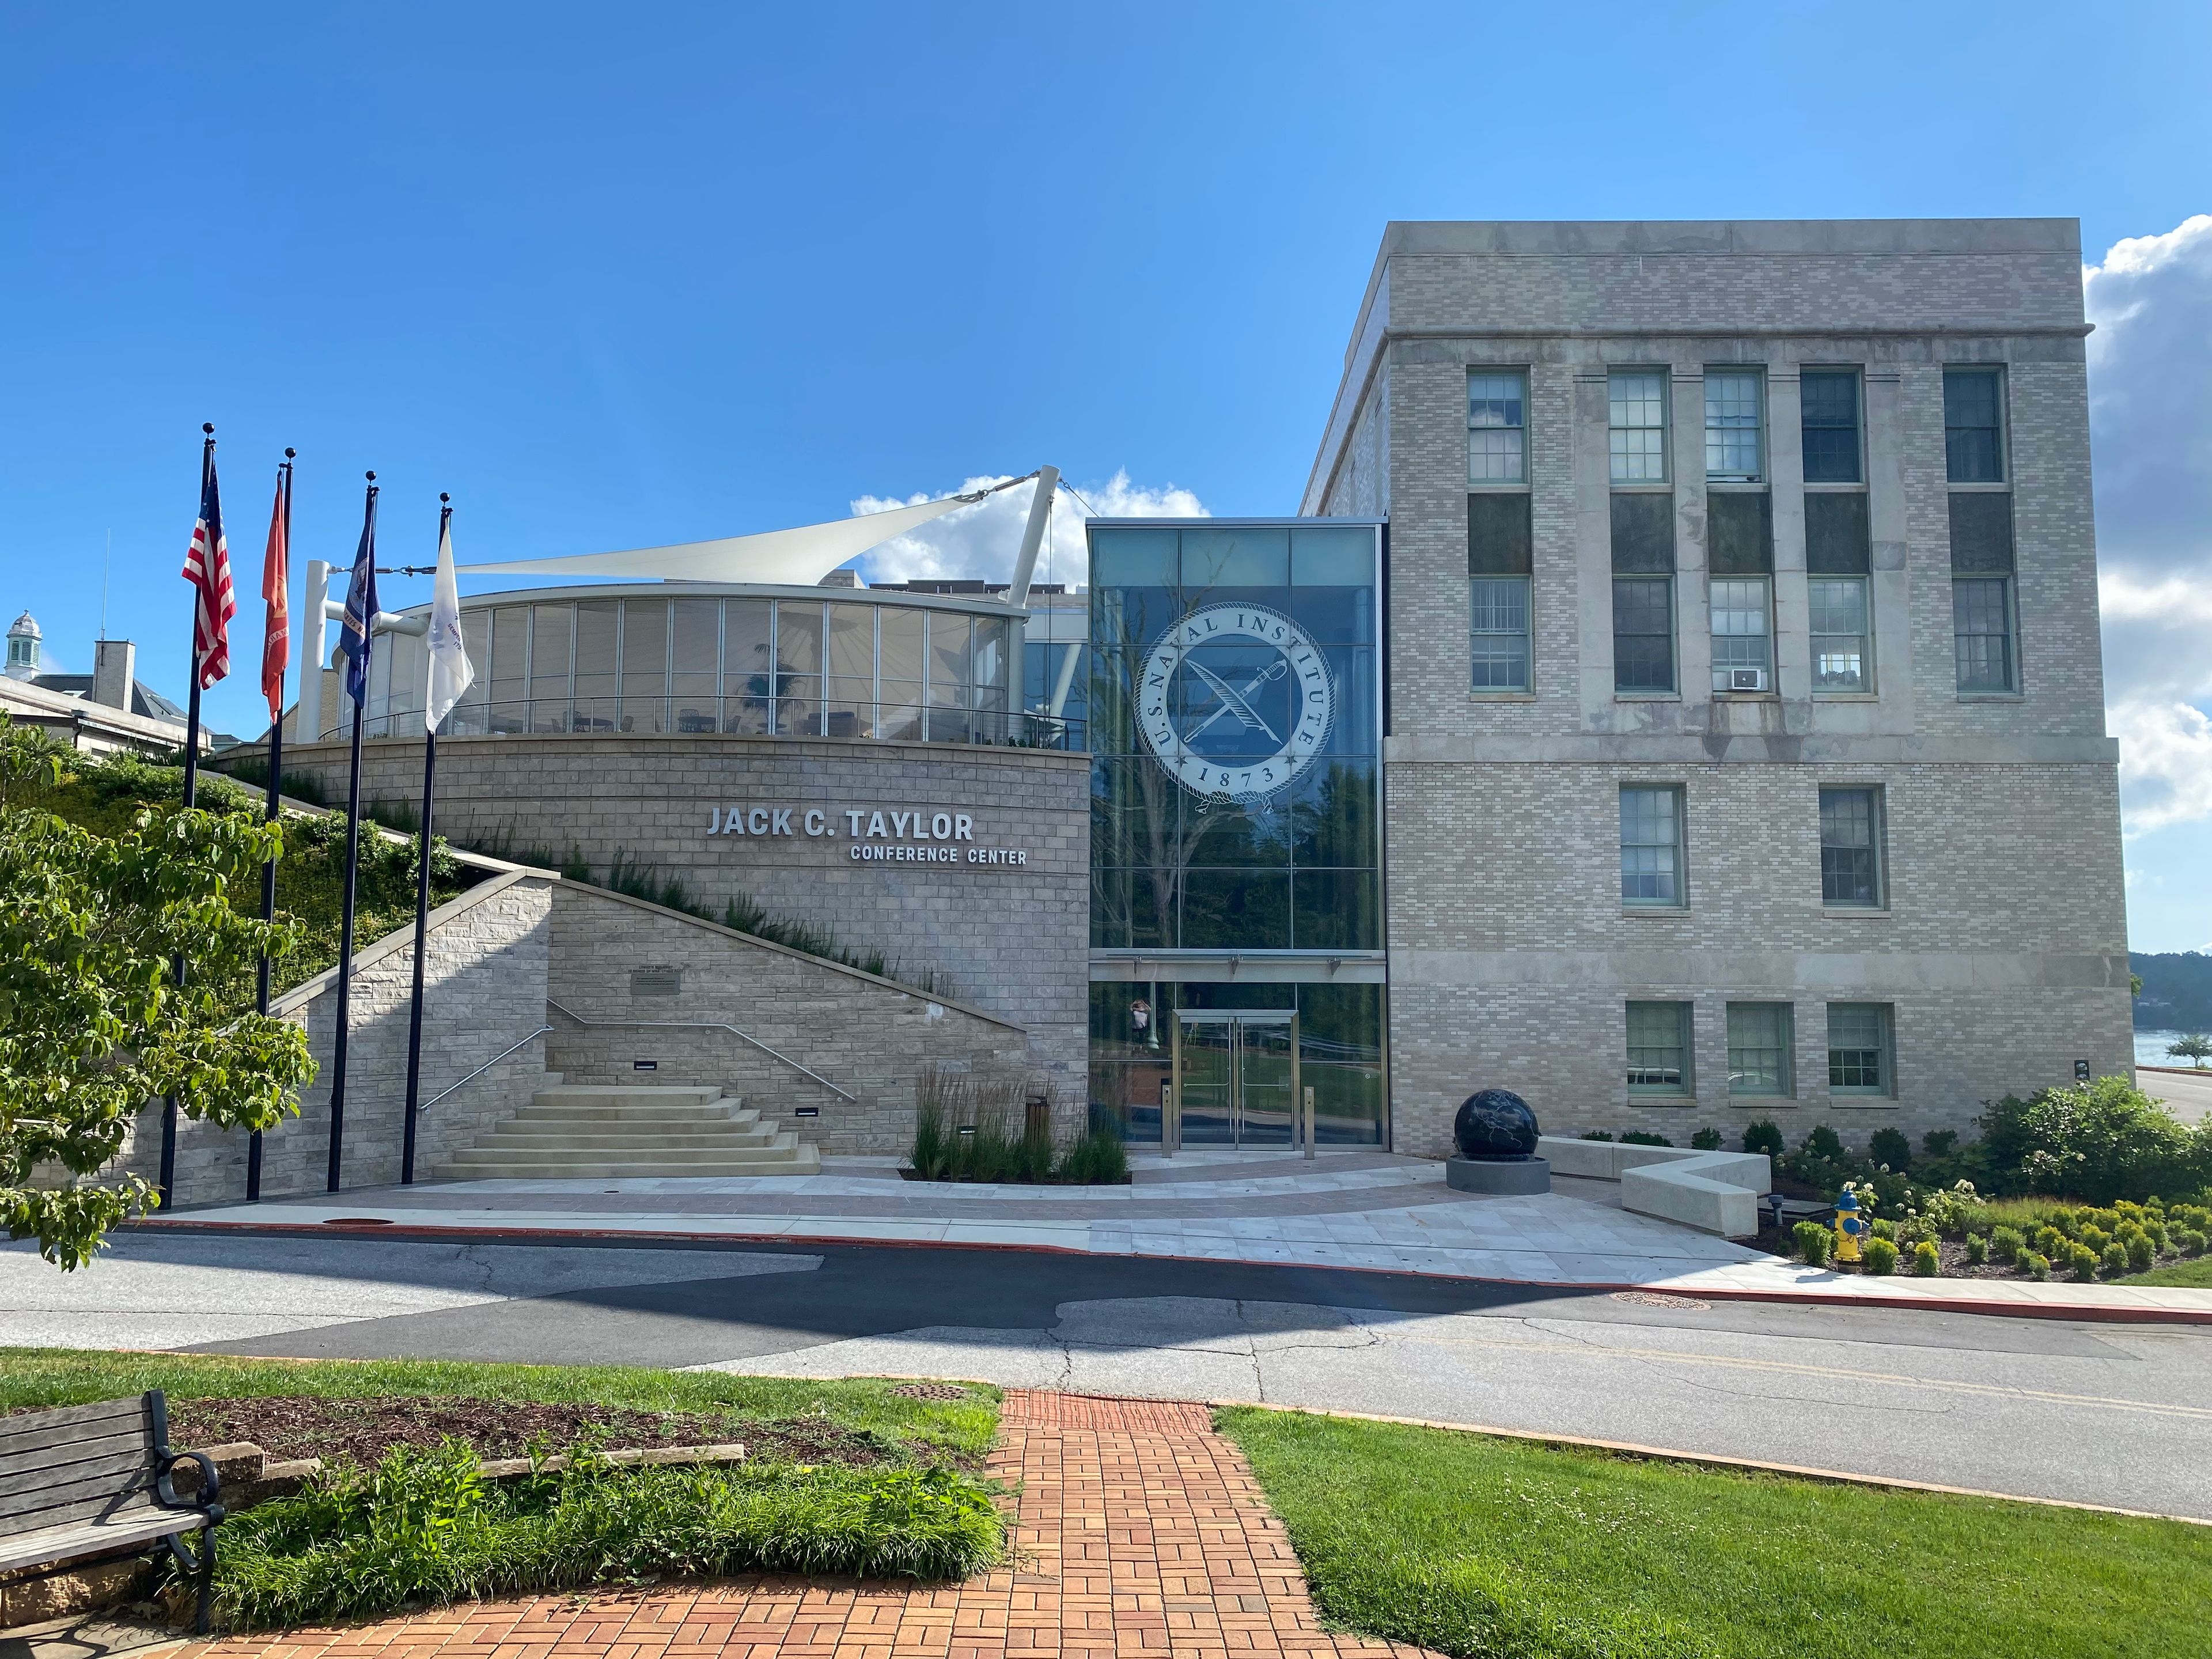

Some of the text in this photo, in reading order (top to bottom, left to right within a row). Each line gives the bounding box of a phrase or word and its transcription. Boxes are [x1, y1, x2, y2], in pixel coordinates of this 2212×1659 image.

[453, 641, 462, 652] 179
[1149, 617, 1218, 689] NAVAL
[1237, 613, 1324, 745] INSTITUTE
[1198, 767, 1274, 787] 1873
[707, 808, 972, 840] JACK C. TAYLOR
[850, 845, 1027, 865] CONFERENCE CENTER
